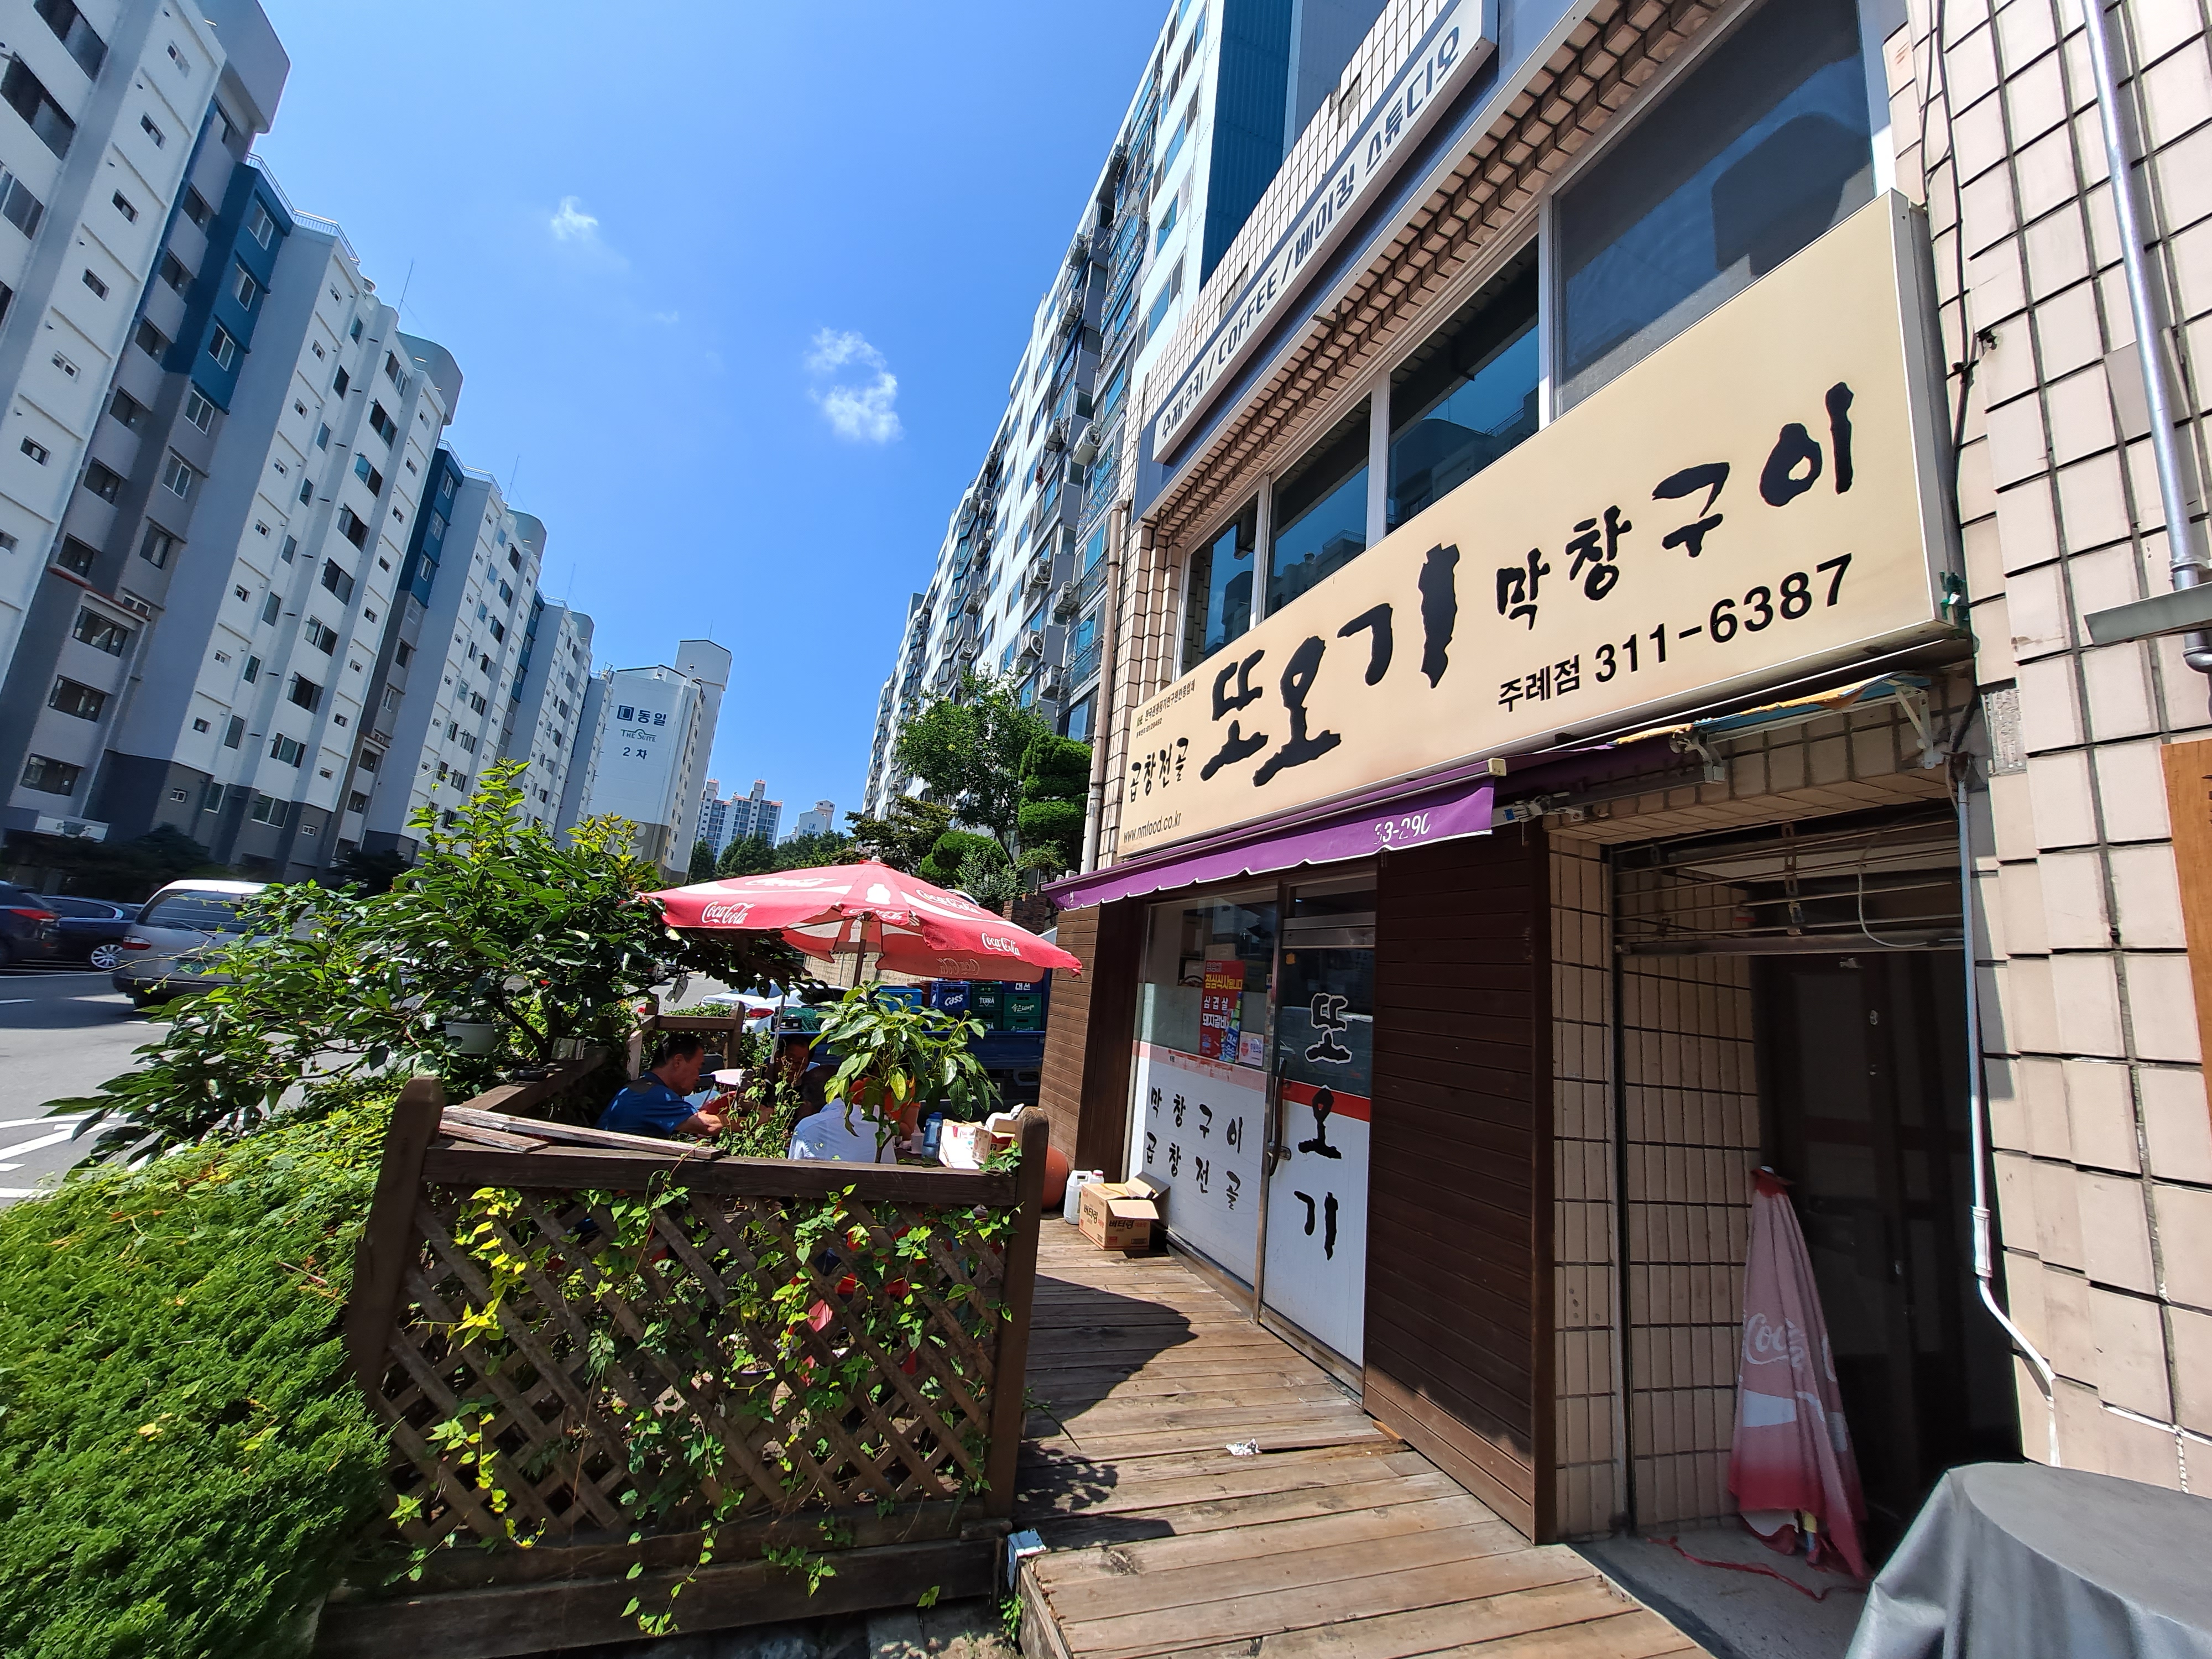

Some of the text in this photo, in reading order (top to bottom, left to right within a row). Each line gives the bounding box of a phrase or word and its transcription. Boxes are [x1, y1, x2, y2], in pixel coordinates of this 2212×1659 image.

[1218, 268, 1277, 365] COFFEE
[1295, 161, 1355, 269] 베이킹
[1365, 26, 1459, 178] 스튜디오
[1498, 553, 1853, 712] 주례점 311-6387
[1200, 542, 1460, 787] 또오기
[638, 709, 666, 726] 동일
[1130, 737, 1189, 803] 곱창전골
[1124, 810, 1181, 844] www.nmfood.co.kr
[701, 901, 756, 924] Coca-Cola
[981, 932, 1022, 957] Coca-Cola
[1202, 1013, 1227, 1029] 돼지갈비
[1084, 1203, 1098, 1224] 버터링
[1109, 1220, 1134, 1229] 버터링
